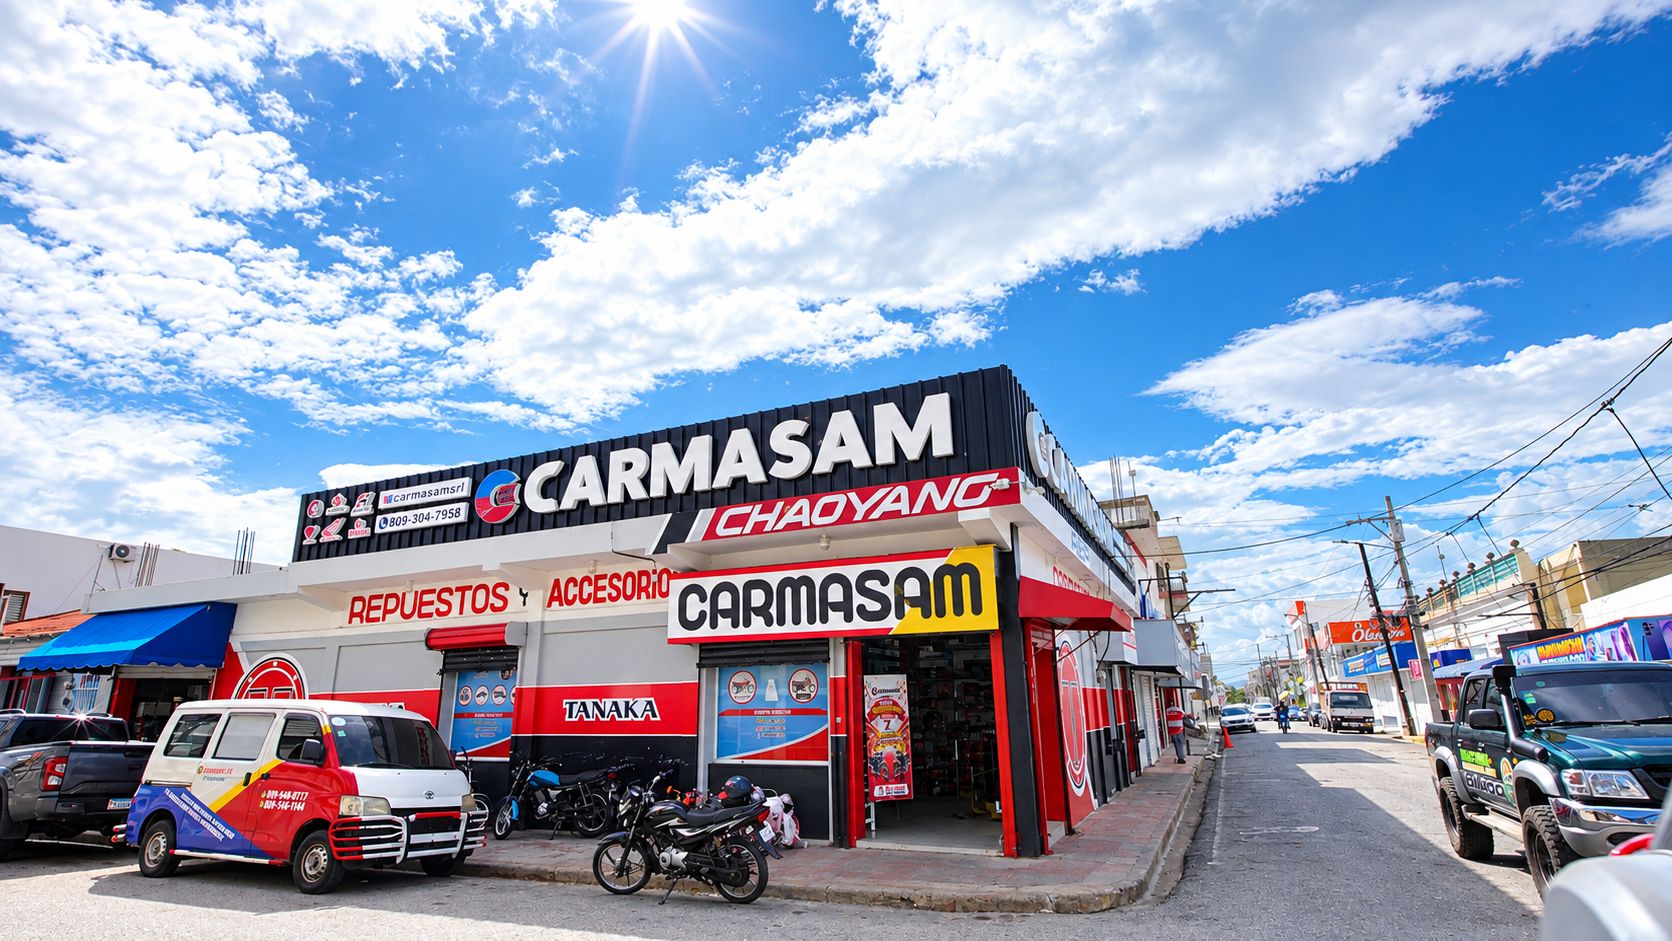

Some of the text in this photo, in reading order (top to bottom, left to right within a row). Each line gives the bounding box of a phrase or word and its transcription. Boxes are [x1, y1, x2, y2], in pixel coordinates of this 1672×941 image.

[523, 392, 954, 514] CARMASAM
[389, 507, 461, 528] 809-304-7958
[393, 482, 465, 504] carmasamsrl
[715, 472, 998, 536] CHAOYANG
[348, 582, 510, 624] REPUESTOS
[546, 567, 678, 608] ACCESORIO
[678, 563, 983, 631] CARMASAM
[565, 699, 659, 720] TANAKA
